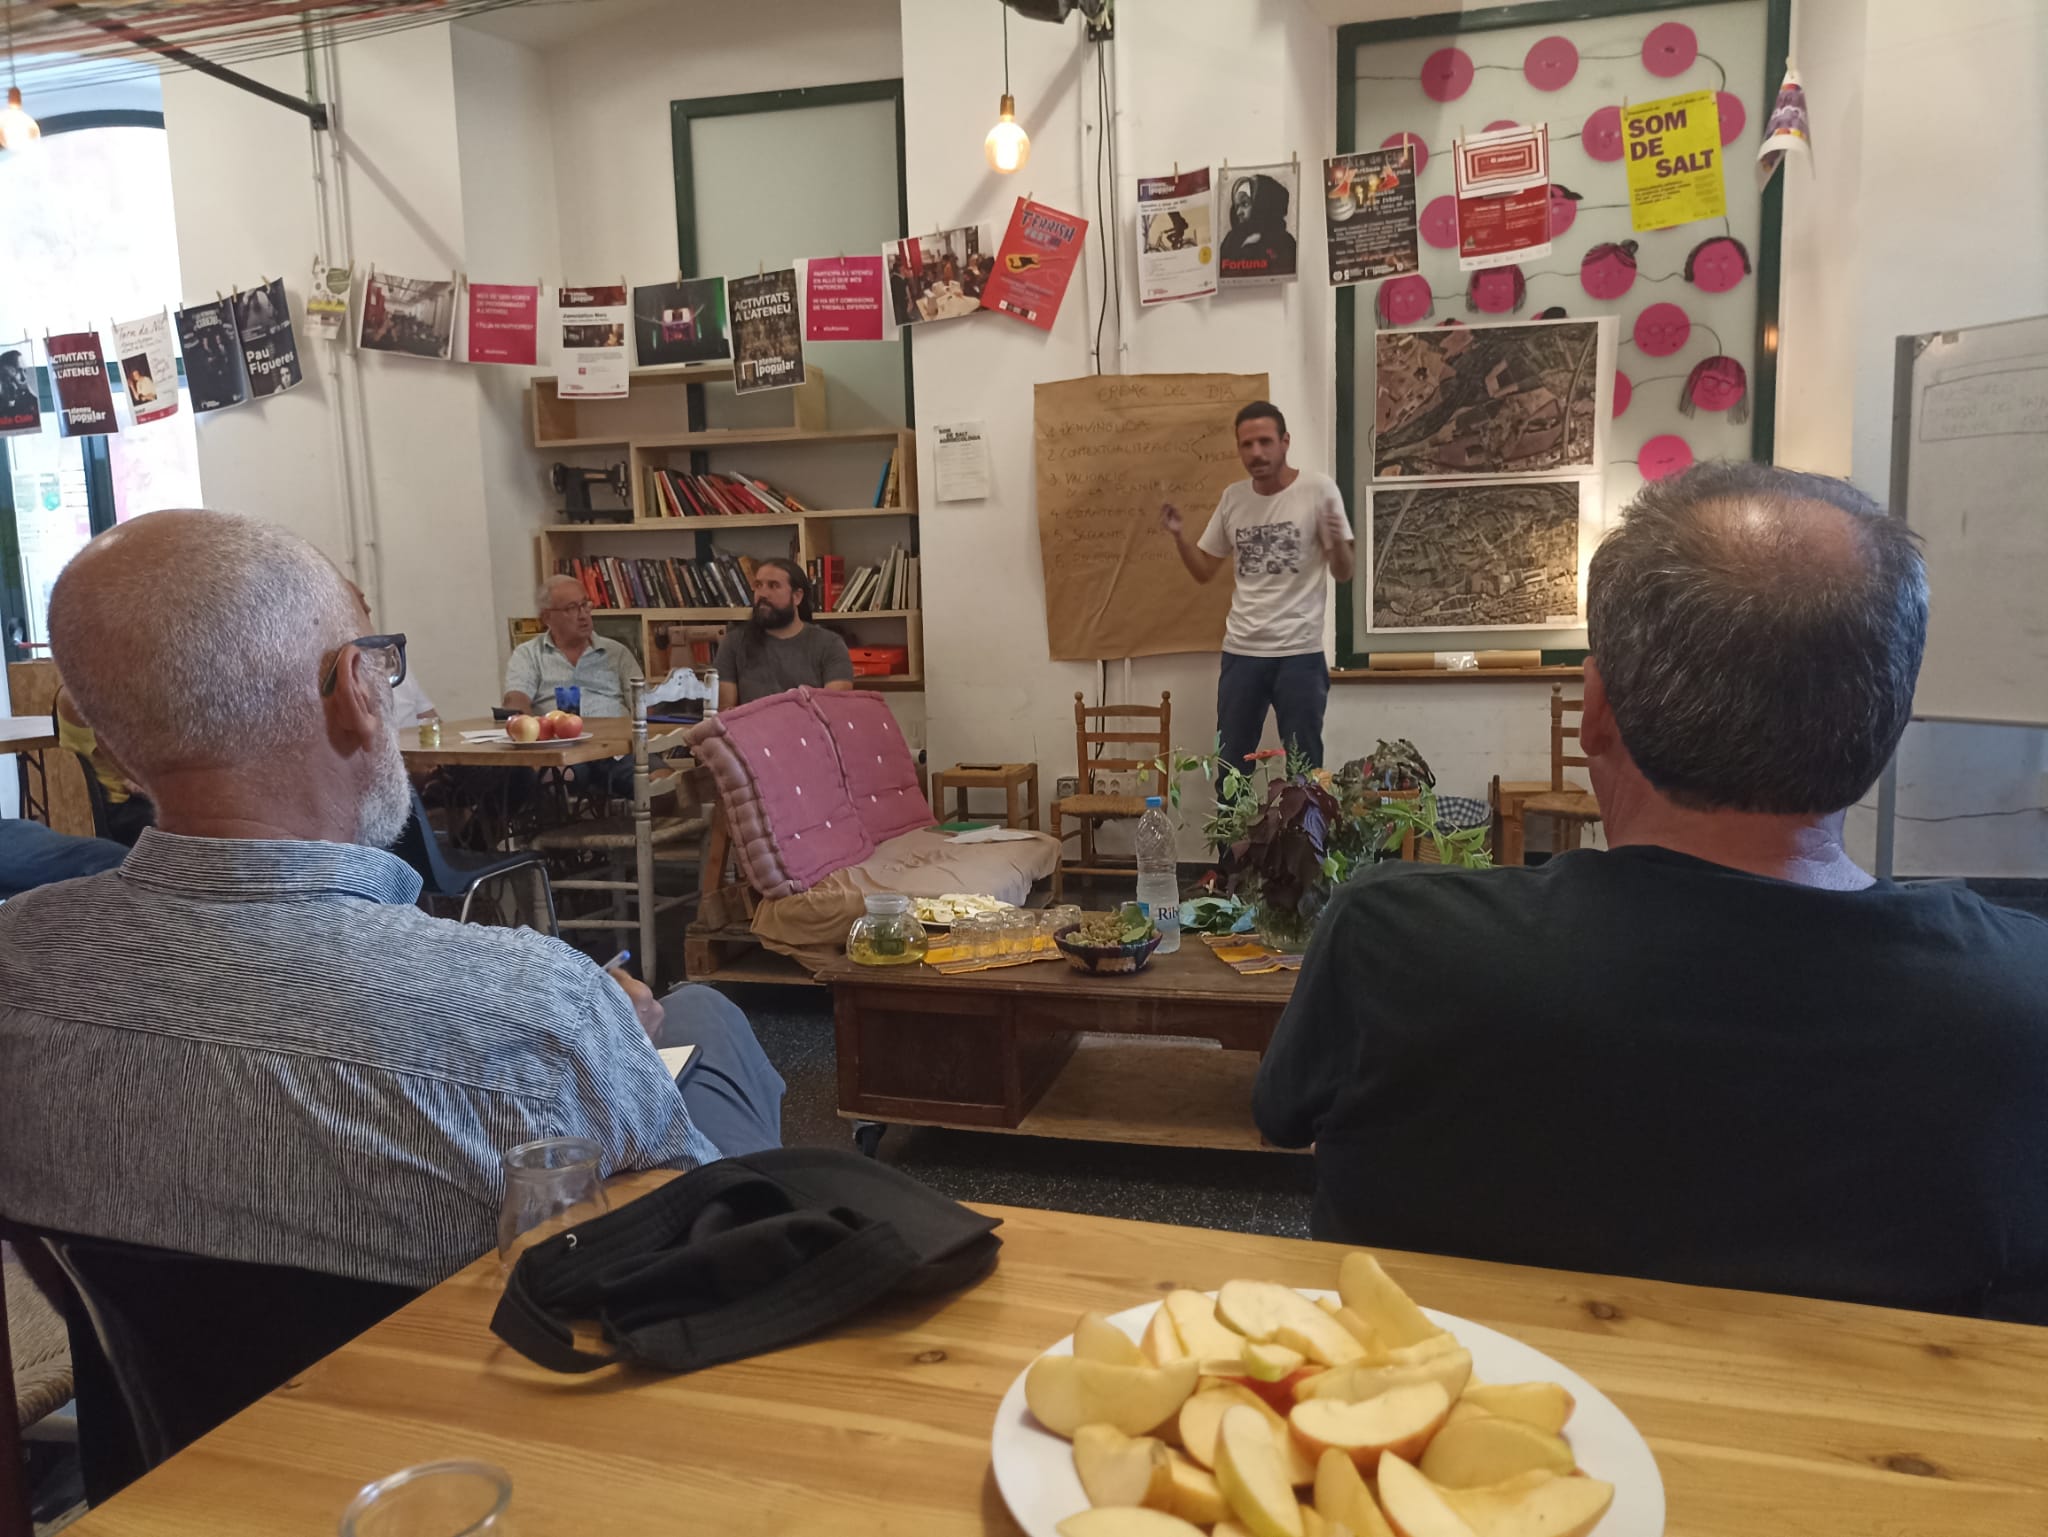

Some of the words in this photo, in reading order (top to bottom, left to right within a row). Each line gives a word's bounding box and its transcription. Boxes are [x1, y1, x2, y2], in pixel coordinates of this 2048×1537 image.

[1628, 109, 1687, 138] SOM
[1630, 138, 1664, 161] DE
[1655, 149, 1714, 178] SALT
[1222, 258, 1268, 270] Fortuna
[735, 291, 790, 311] ACTIVITATS
[735, 311, 742, 322] A
[743, 303, 791, 321] L'ATENEU
[246, 348, 270, 362] Pau
[249, 352, 294, 375] Figueres
[759, 356, 782, 366] ateneu
[57, 366, 99, 379] L'ATENEU
[759, 359, 795, 377] popular
[70, 411, 106, 425] popular
